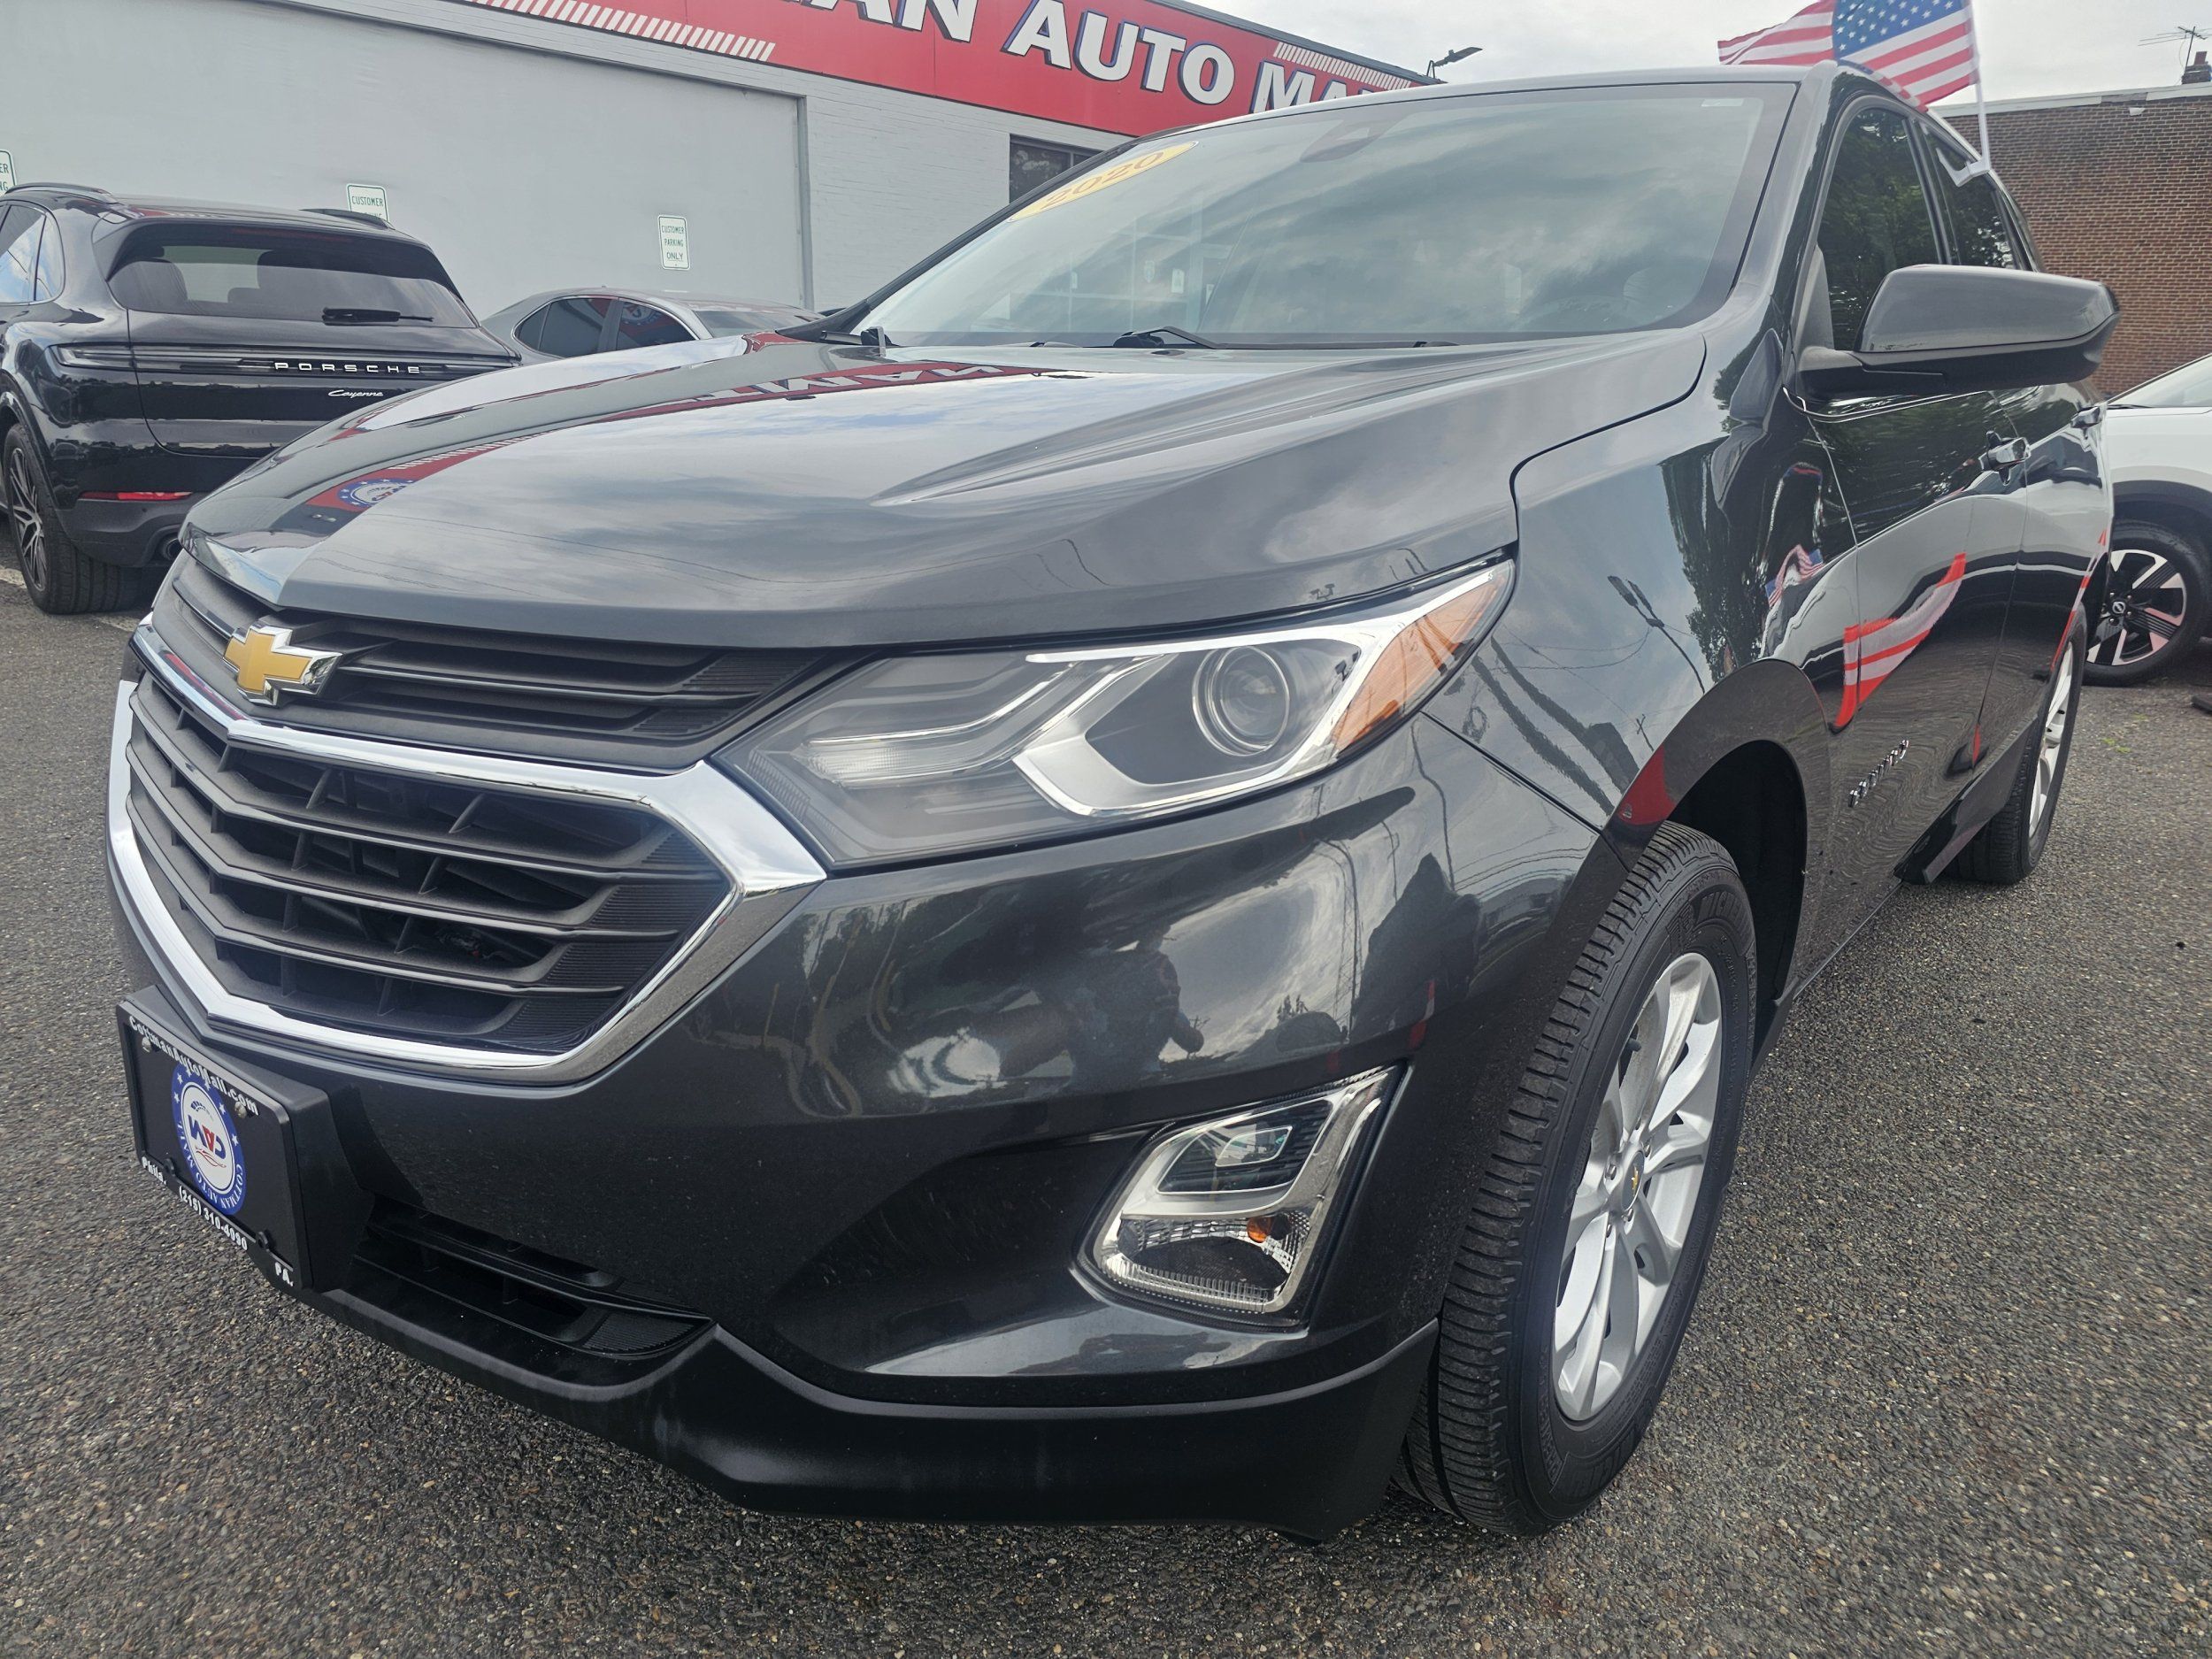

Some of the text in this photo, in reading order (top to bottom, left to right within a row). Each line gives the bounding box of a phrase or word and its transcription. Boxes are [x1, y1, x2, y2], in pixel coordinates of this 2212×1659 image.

[1001, 0, 1236, 105] AUTO
[1041, 151, 1164, 210] 2020
[351, 196, 384, 207] CUSTOMER
[661, 225, 685, 234] CUSTOMER
[664, 238, 684, 247] PARKING
[666, 251, 684, 260] ONLY
[274, 362, 420, 374] PORSCHE
[328, 389, 384, 398] Cayenne
[142, 1156, 294, 1286] Phila. (215) 310-4090 PA.
